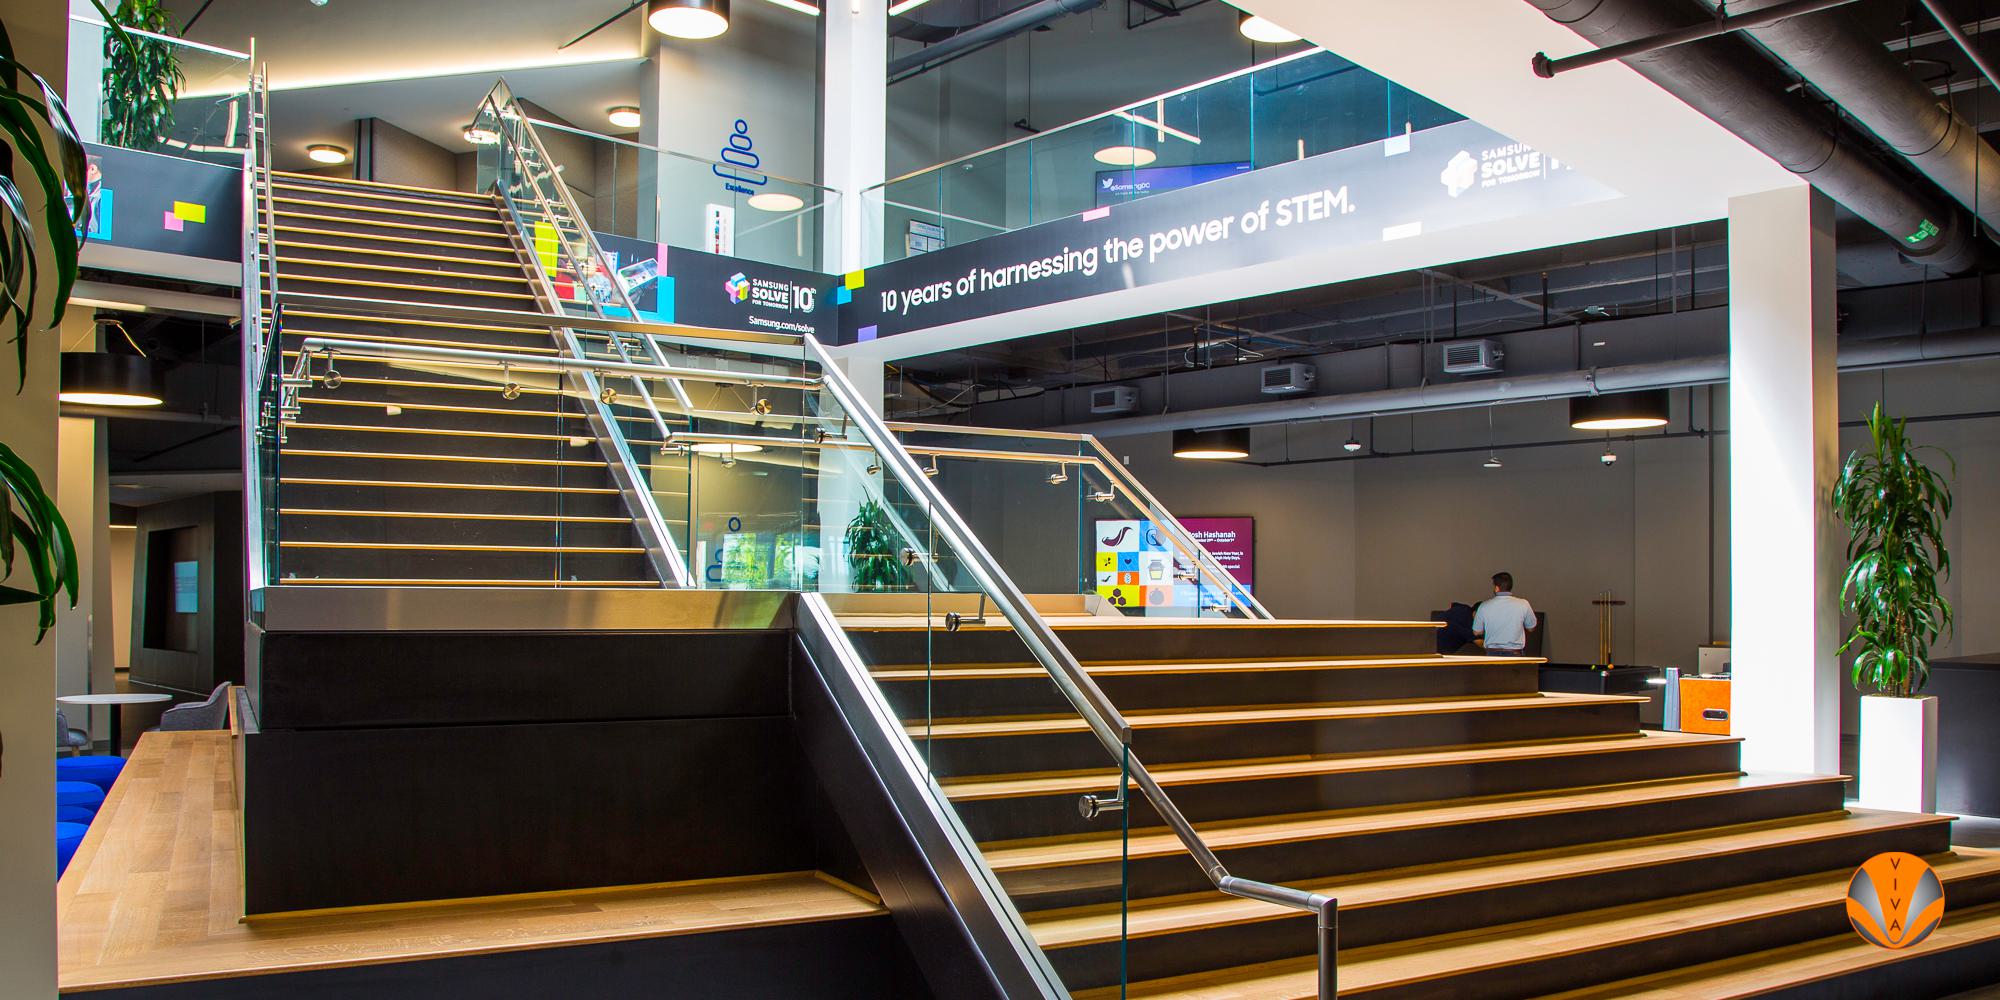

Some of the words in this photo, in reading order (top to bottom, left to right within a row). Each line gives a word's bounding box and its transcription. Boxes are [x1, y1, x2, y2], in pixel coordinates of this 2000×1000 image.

[1481, 143, 1535, 161] SAMSUN
[1481, 151, 1540, 178] SOLVE
[881, 289, 897, 313] 10
[901, 280, 953, 315] years
[956, 268, 977, 296] of
[980, 246, 1099, 292] harnessing
[1103, 236, 1144, 264] the
[1150, 215, 1235, 264] power
[1240, 200, 1270, 234] of
[1275, 185, 1357, 227] STEM.
[752, 278, 789, 292] SAMSUNG
[752, 287, 789, 304] SOLVE
[763, 301, 789, 310] TOMORROW
[749, 316, 815, 334] Samsung.com/solve
